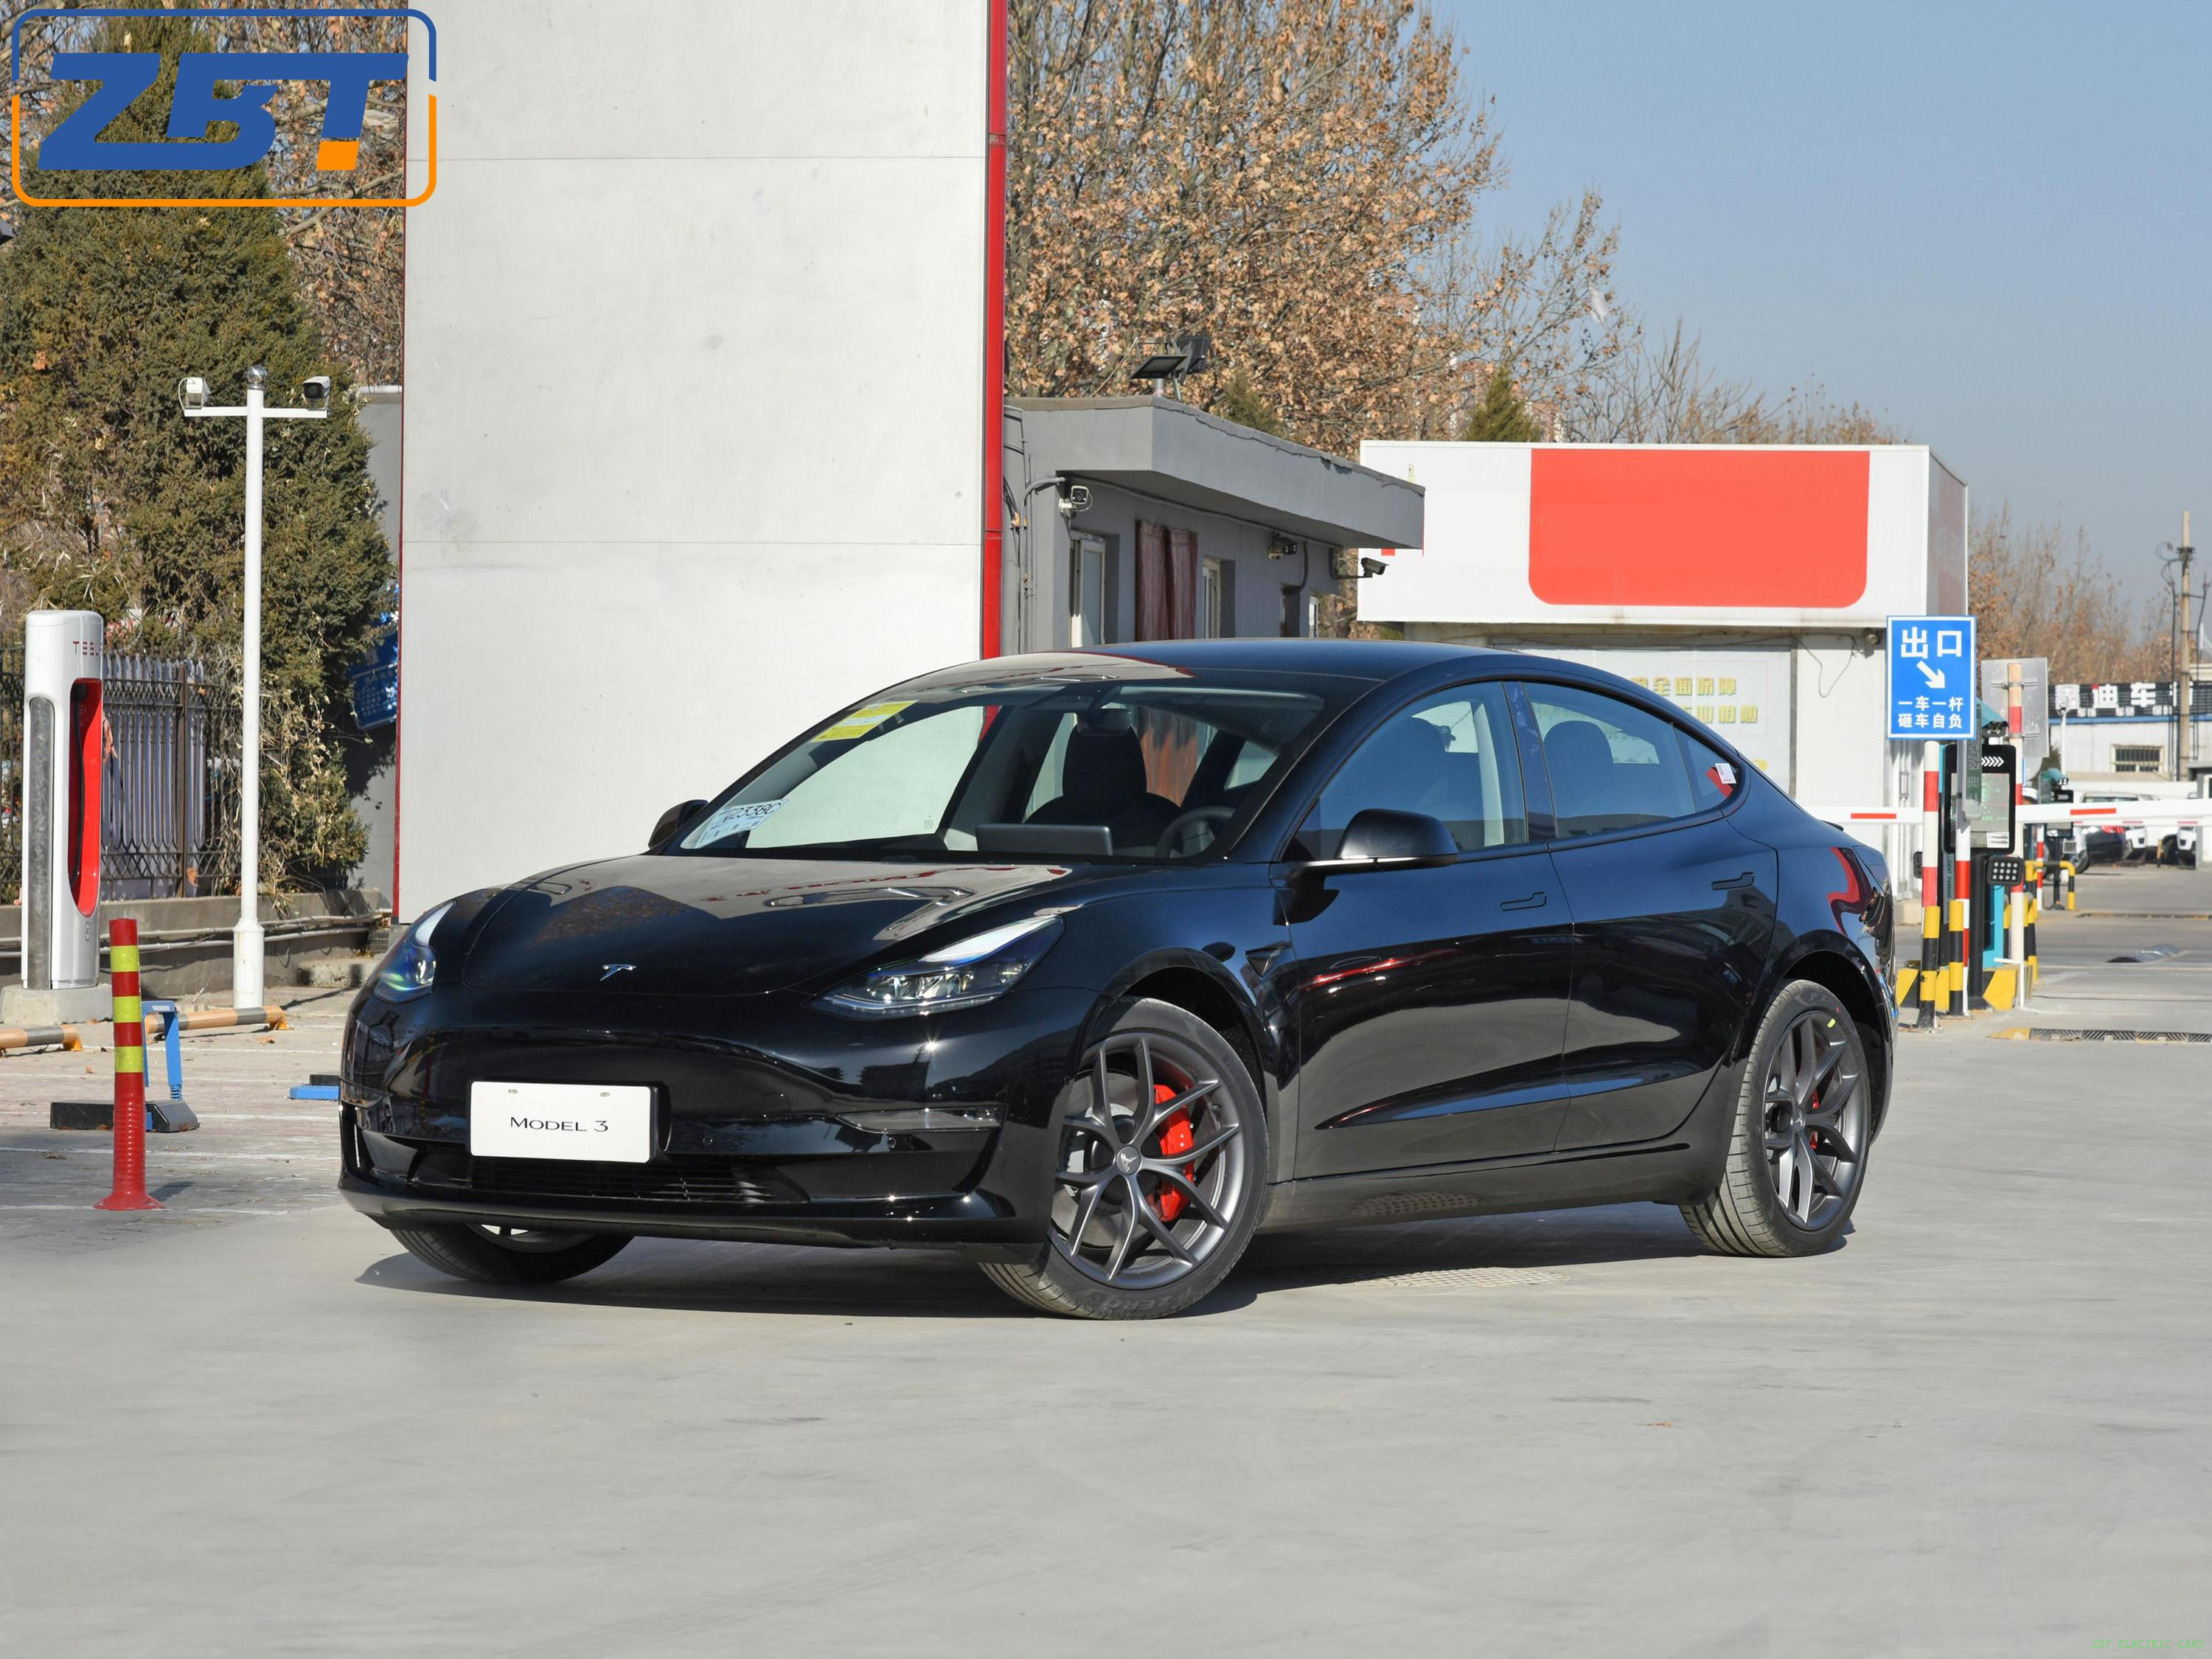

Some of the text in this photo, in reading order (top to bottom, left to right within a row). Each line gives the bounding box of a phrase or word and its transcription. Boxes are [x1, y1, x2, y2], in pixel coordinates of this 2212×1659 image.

[1901, 627, 1962, 659] 出口
[1899, 696, 1964, 712] 一车一杆
[1898, 713, 1963, 729] 砸车自负
[594, 1120, 608, 1132] 3
